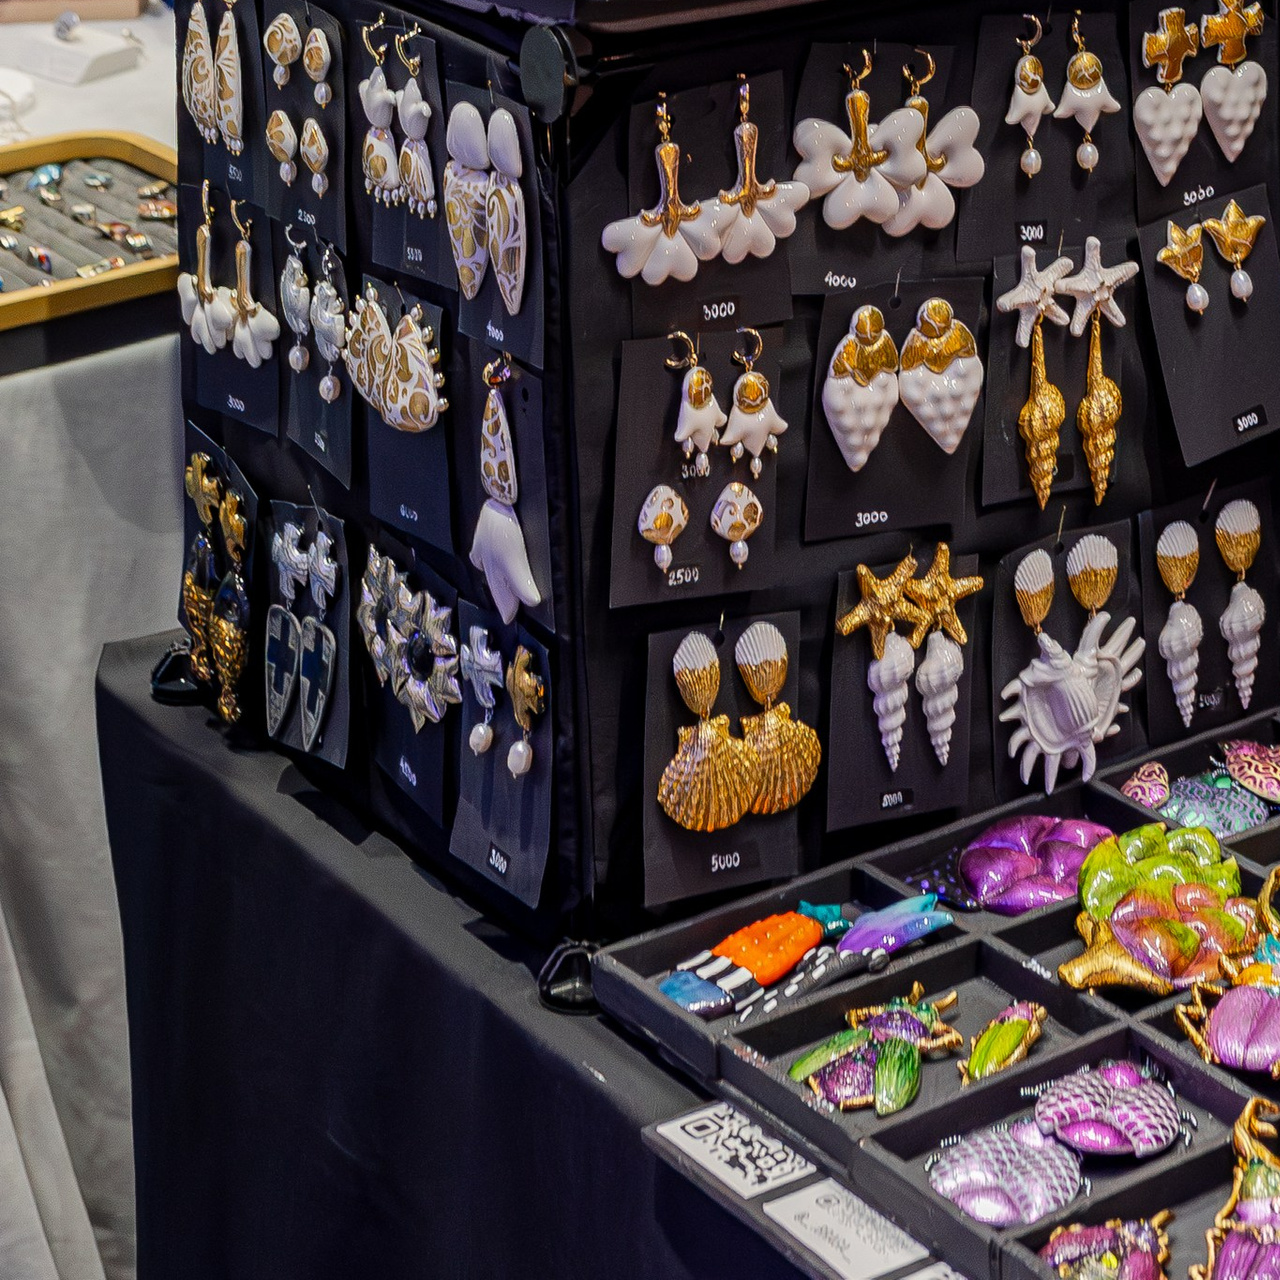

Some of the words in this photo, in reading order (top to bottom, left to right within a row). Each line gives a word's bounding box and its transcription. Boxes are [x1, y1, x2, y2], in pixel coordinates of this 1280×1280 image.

[1181, 184, 1214, 206] 3000
[1020, 224, 1045, 241] 3000
[823, 271, 857, 289] 4000
[702, 301, 736, 321] 3000
[1236, 412, 1259, 432] 3000
[855, 510, 888, 528] 3000
[668, 566, 699, 586] 2500
[711, 851, 741, 873] 5000
